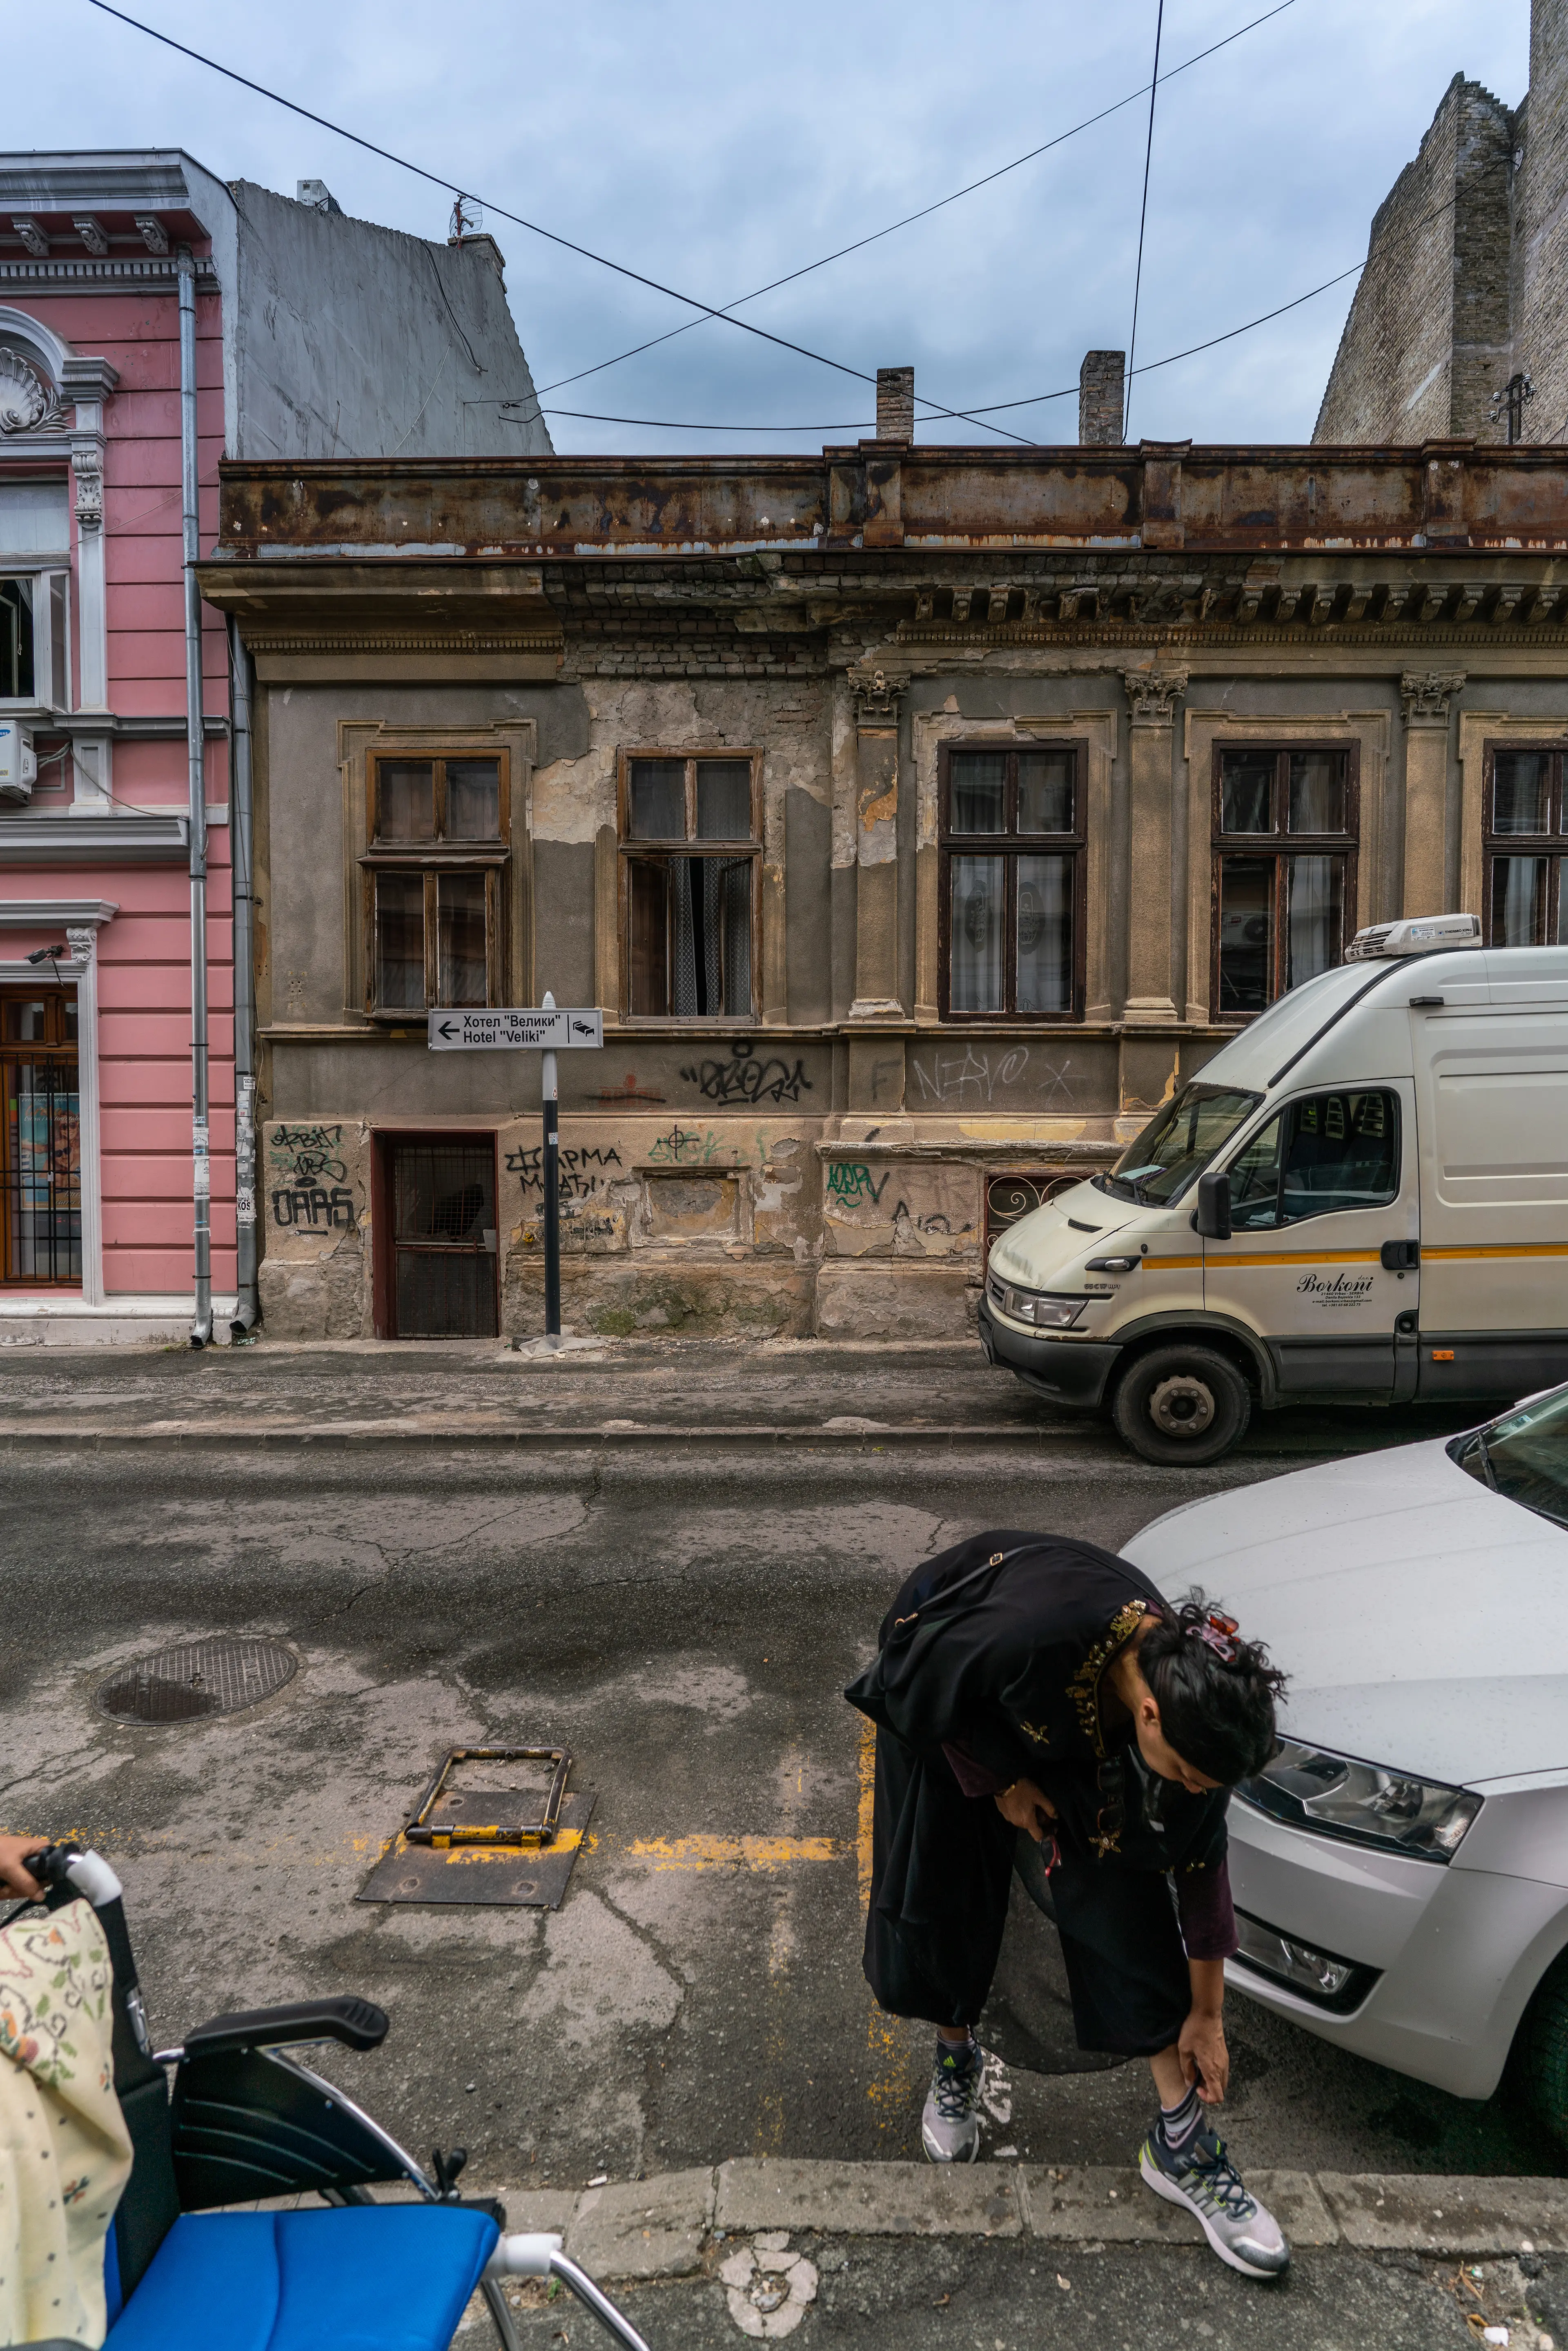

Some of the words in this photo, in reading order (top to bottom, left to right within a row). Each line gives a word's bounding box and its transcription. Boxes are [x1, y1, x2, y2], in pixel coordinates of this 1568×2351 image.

[463, 1016, 500, 1027] Хотел
[504, 1015, 561, 1027] "Велики"
[464, 1031, 496, 1043] Hotel
[500, 1030, 545, 1042] "Veliki"
[1296, 1273, 1374, 1292] Borkoni
